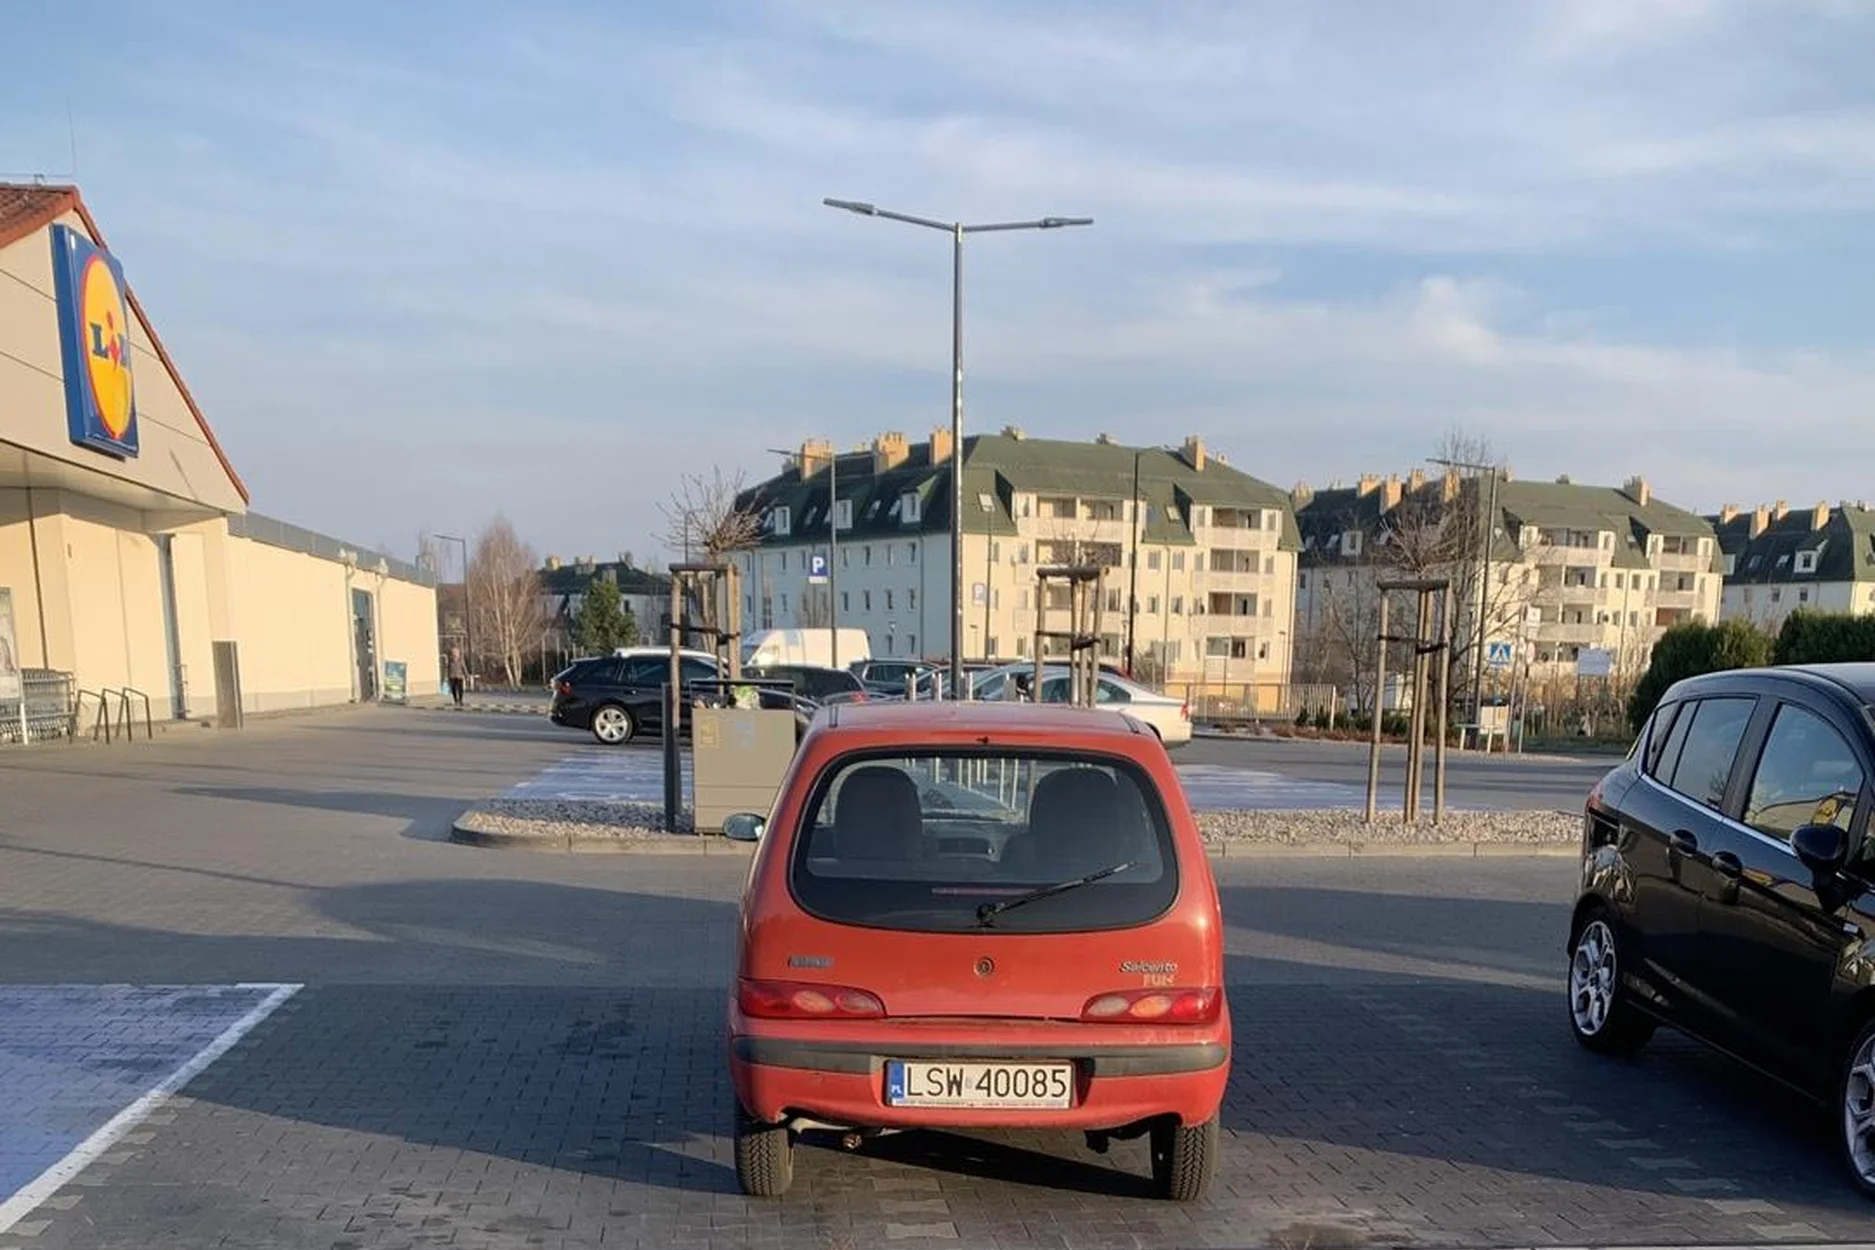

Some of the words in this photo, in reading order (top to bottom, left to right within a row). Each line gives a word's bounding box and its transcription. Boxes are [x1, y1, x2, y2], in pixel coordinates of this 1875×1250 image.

[812, 556, 824, 573] P
[907, 1066, 964, 1097] LSW
[975, 1068, 1068, 1098] 40085
